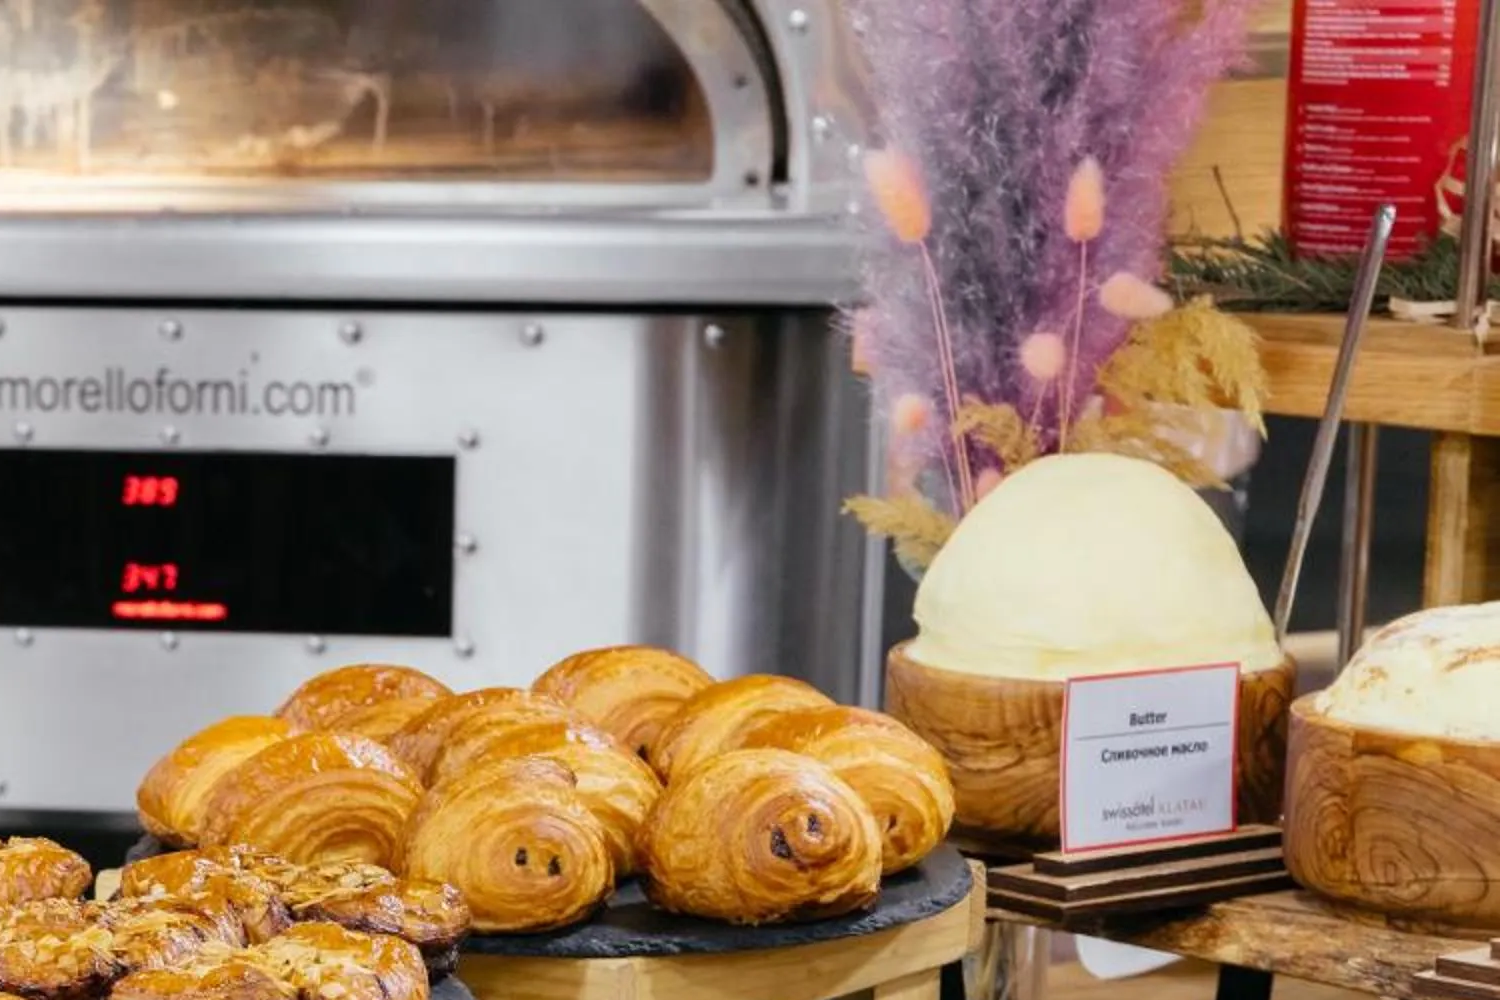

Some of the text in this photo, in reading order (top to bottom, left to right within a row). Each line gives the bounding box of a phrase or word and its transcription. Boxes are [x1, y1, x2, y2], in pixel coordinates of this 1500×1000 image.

[1129, 711, 1167, 727] Butter
[1101, 740, 1209, 764] Сливочное масло
